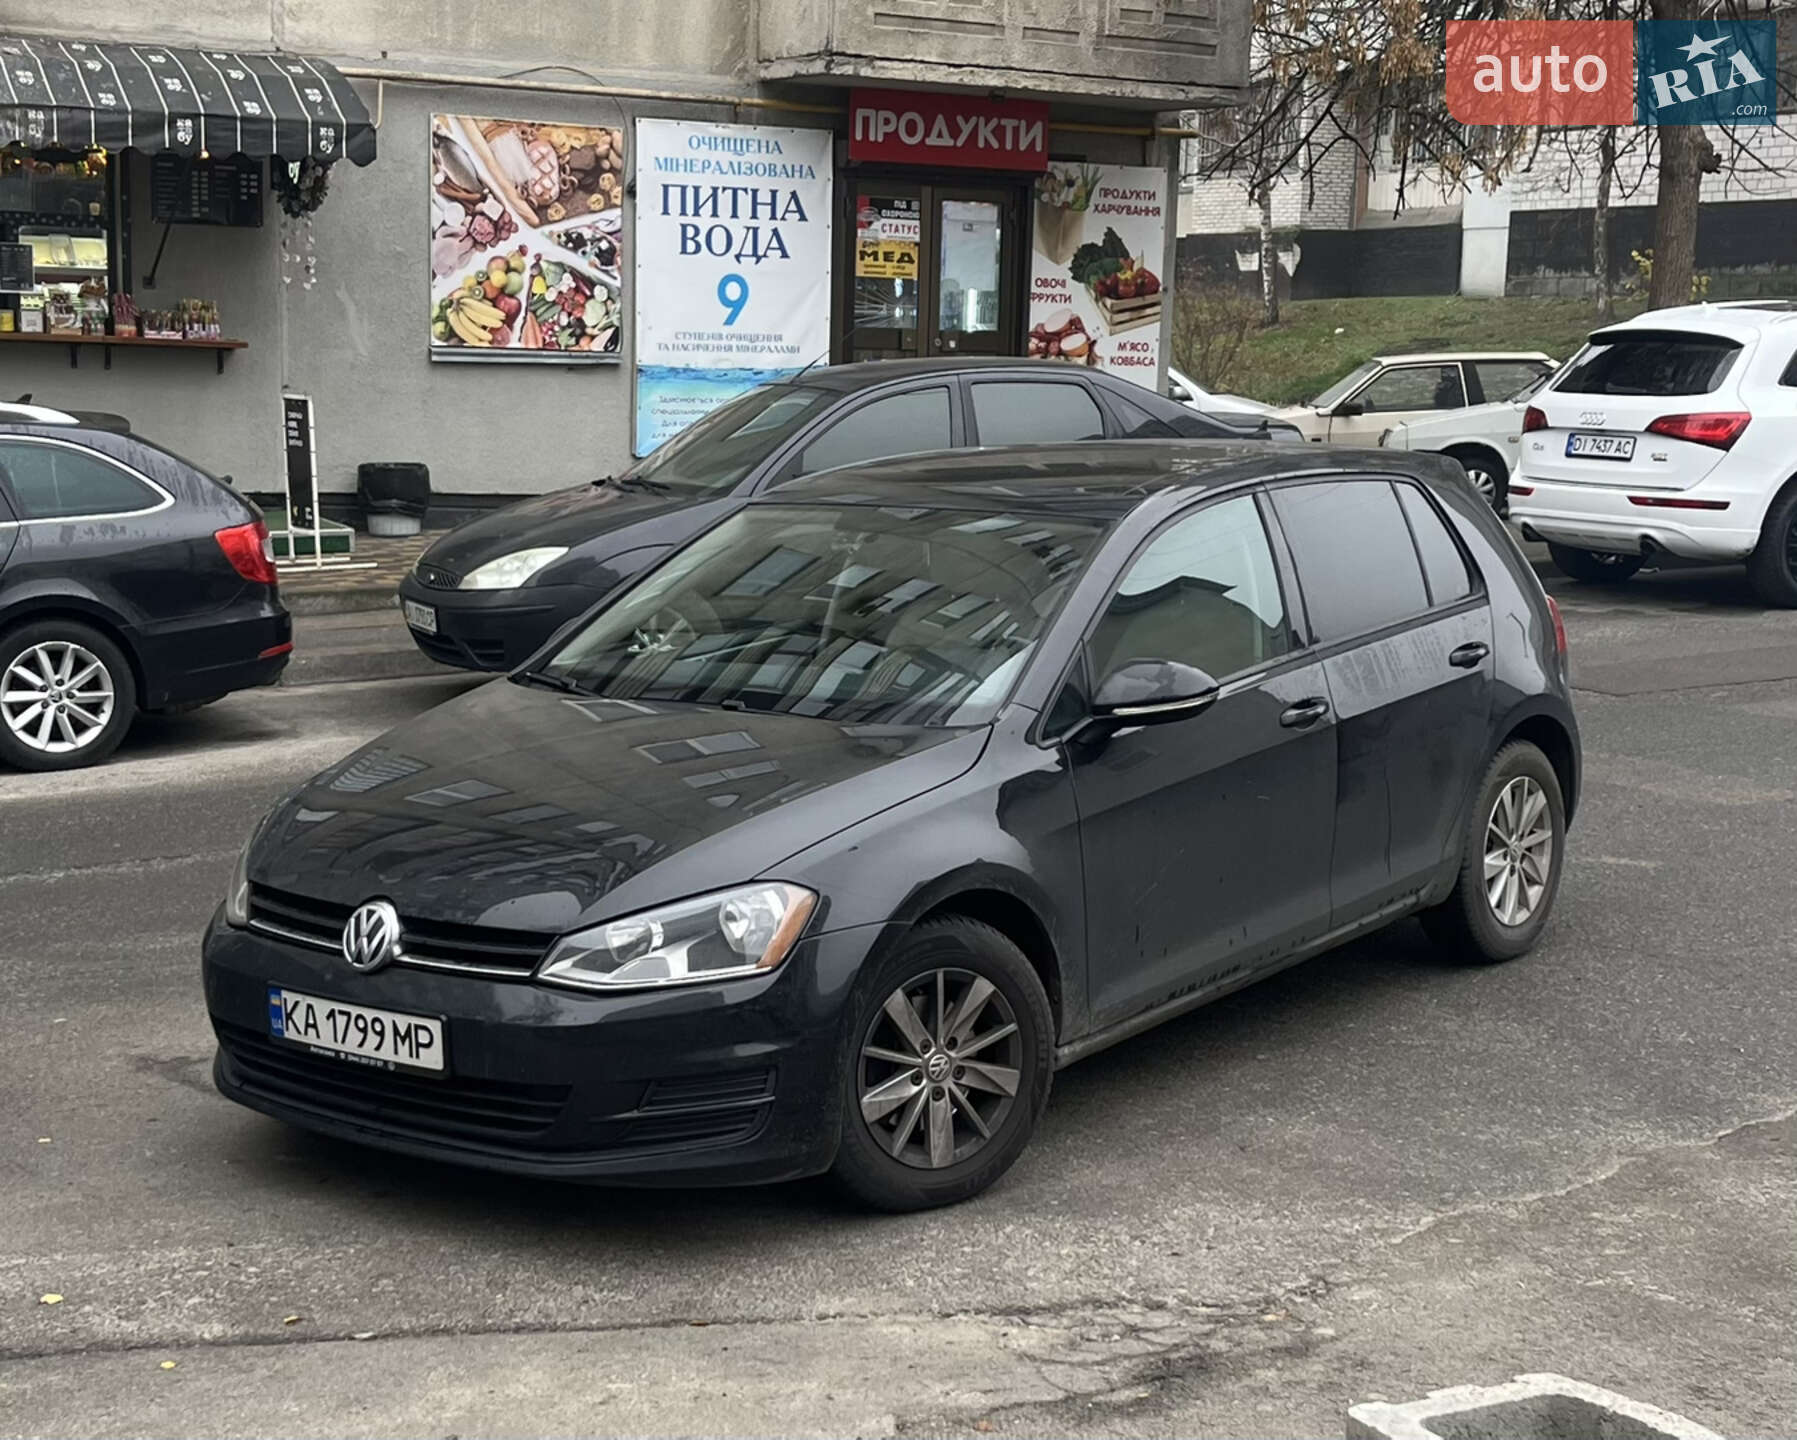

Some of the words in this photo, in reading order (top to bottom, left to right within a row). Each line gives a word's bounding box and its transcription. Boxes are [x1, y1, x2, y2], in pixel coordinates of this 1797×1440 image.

[855, 108, 1044, 152] ПРОДУКТИ
[688, 134, 783, 156] ОЧИЩЕНА
[654, 156, 816, 180] МІНЕРАЛІЗОВАНА
[660, 183, 808, 222] ПИТНА
[1099, 187, 1156, 201] ПРОДУКТИ
[1093, 203, 1161, 217] ХАРЧУВАННЯ
[881, 223, 919, 235] СТАТУС
[679, 222, 790, 264] ВОДА
[1035, 277, 1067, 288] ОВОЧІ
[717, 273, 749, 326] 9
[1110, 355, 1156, 367] КОВБАСА
[283, 997, 321, 1039] KA
[325, 1007, 386, 1051] 1799
[391, 1018, 434, 1060] MP
